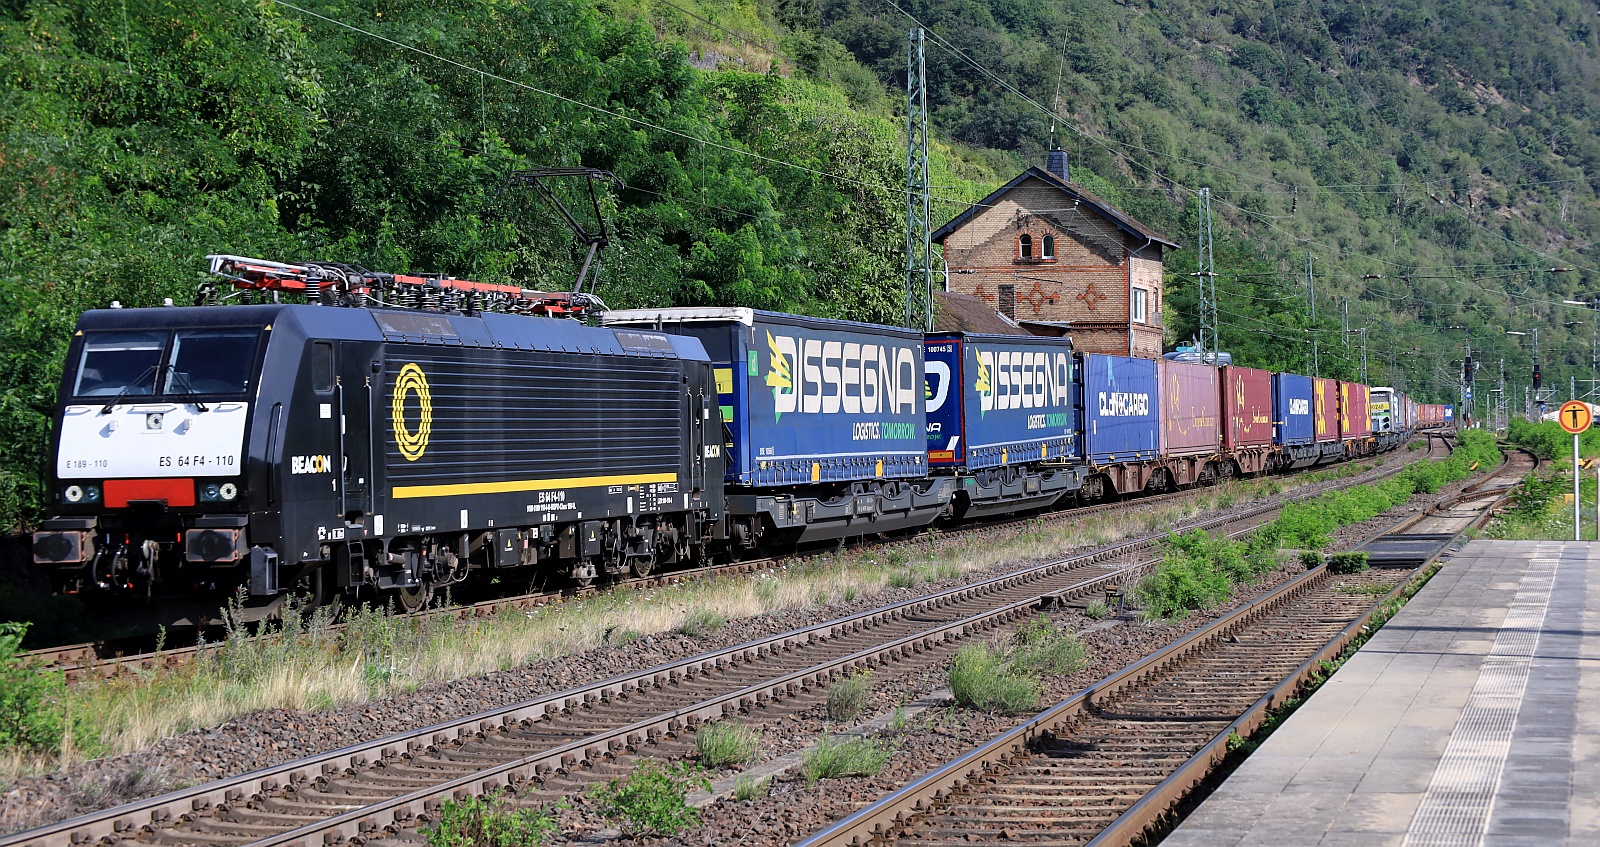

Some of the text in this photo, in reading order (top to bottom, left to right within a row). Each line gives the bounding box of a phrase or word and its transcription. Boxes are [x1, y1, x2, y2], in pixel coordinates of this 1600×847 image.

[774, 335, 916, 414] DISSEGNA
[980, 351, 1068, 411] DISSEGNA
[1122, 392, 1149, 417] CARGO
[852, 422, 916, 441] LOGISTICS. TOMORROW.
[159, 456, 172, 467] ES
[178, 455, 190, 467] 64
[193, 455, 205, 467] F4
[216, 454, 234, 466] 110
[704, 444, 721, 459] BEACON
[66, 460, 71, 469] E
[73, 460, 87, 469] 189
[95, 459, 108, 468] 110
[291, 454, 332, 475] BEACON
